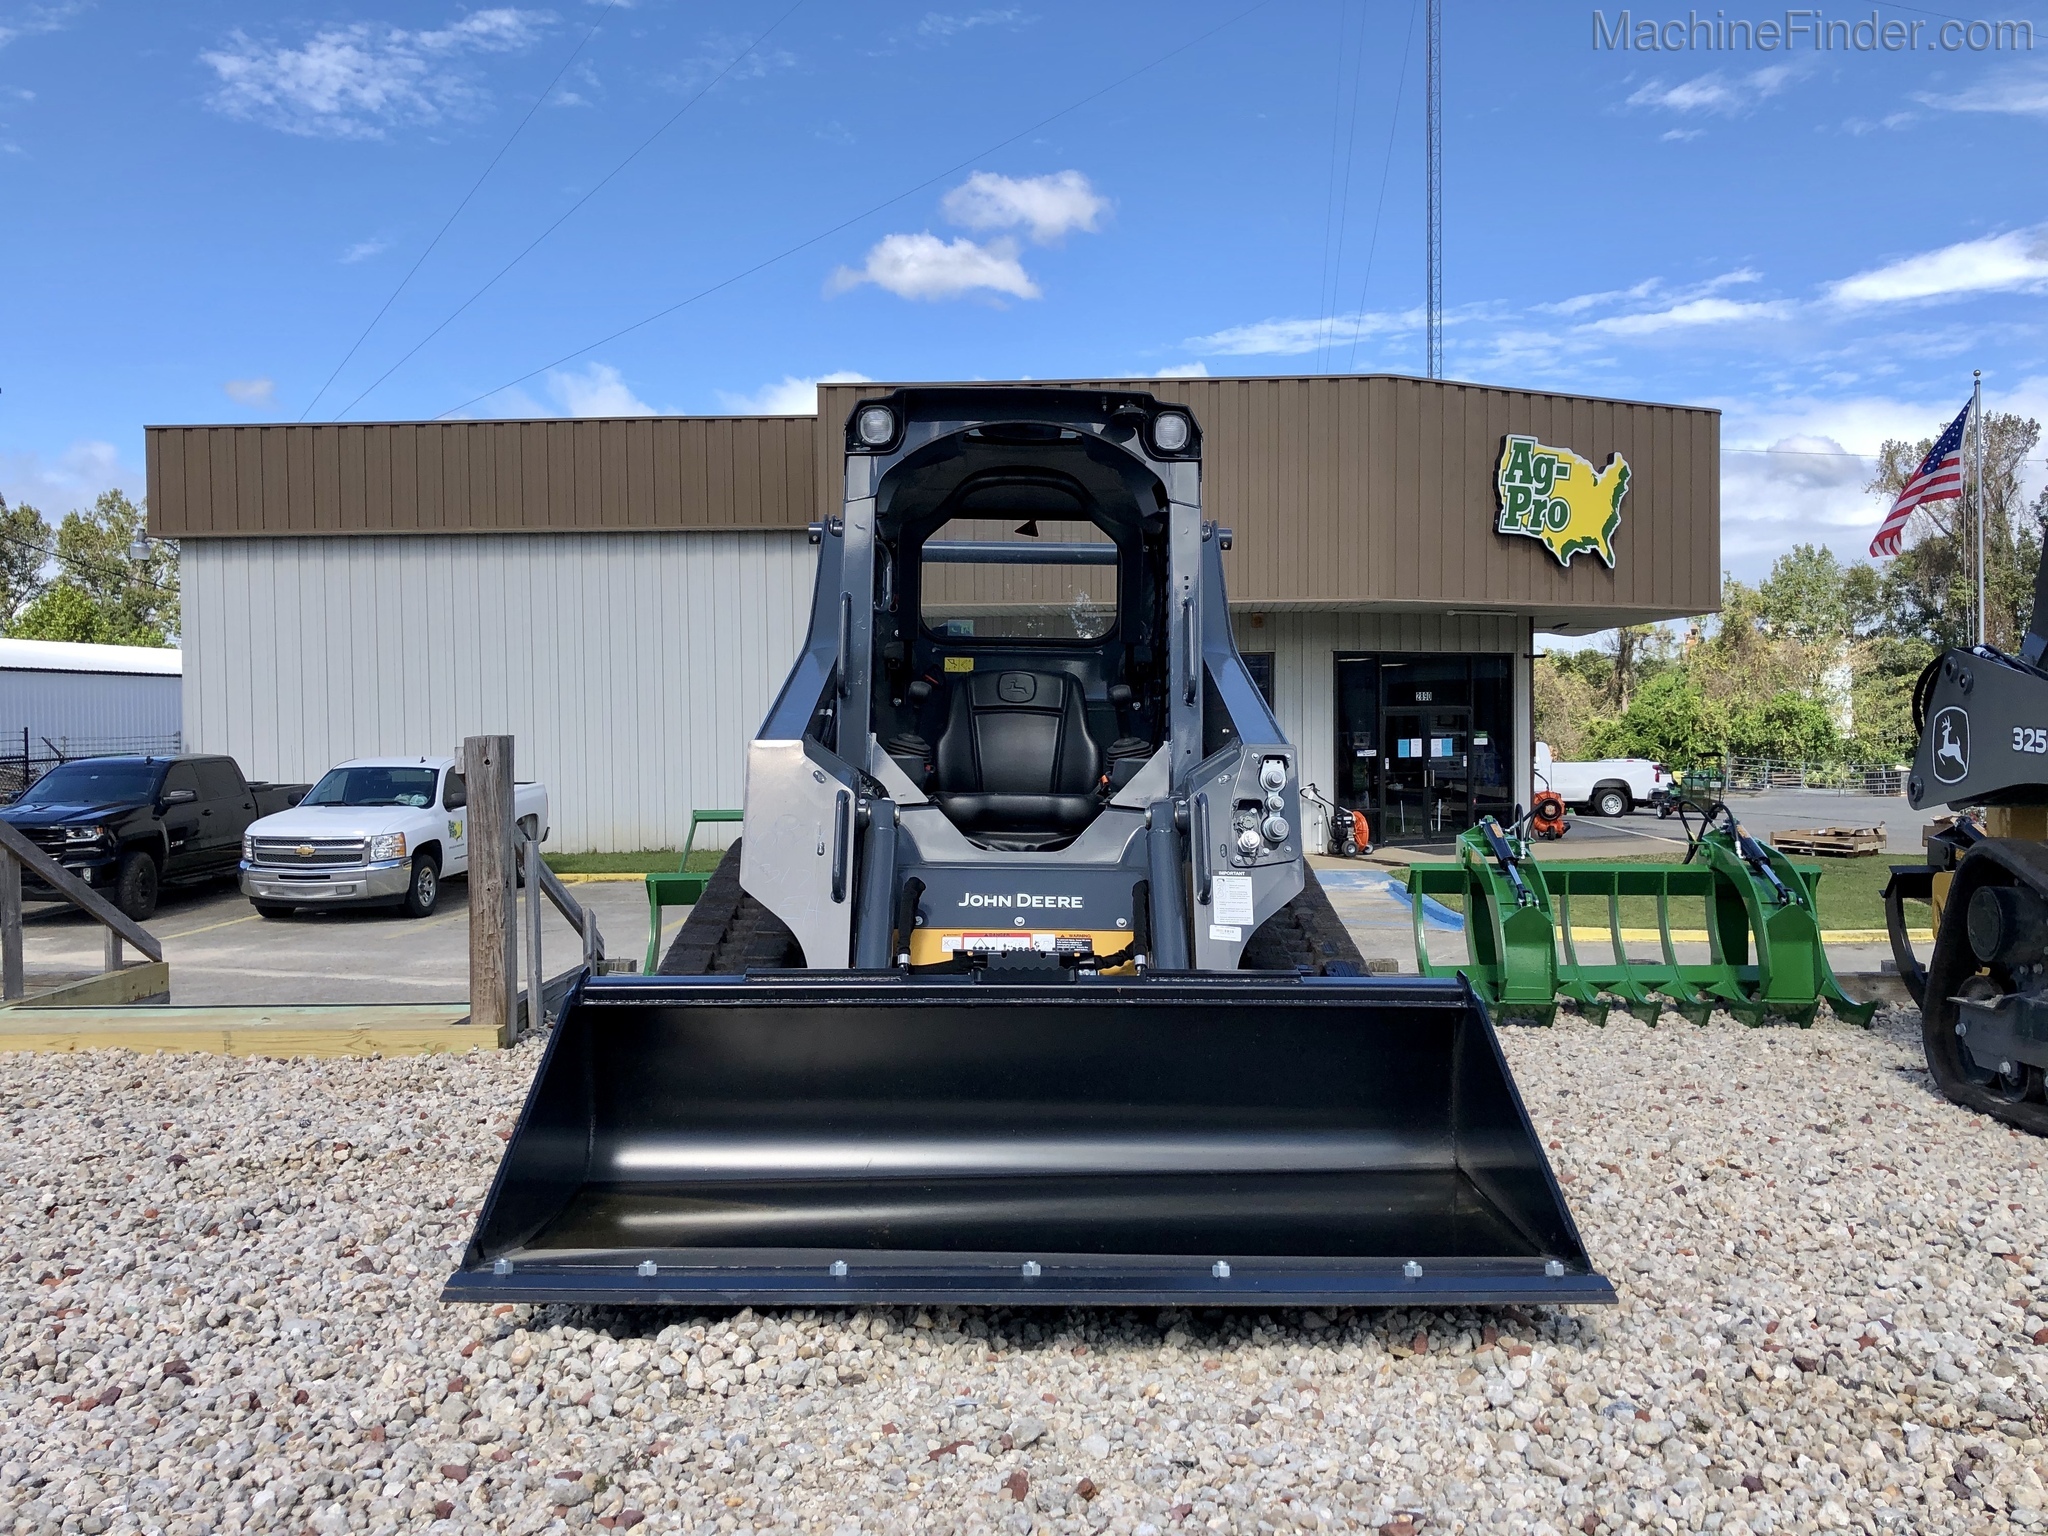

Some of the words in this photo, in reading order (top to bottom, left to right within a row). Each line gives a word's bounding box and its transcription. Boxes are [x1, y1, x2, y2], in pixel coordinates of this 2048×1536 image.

[1503, 439, 1571, 497] Ag-
[1501, 484, 1570, 532] Pro
[958, 892, 1012, 908] JOHN
[1016, 893, 1083, 909] DEERE
